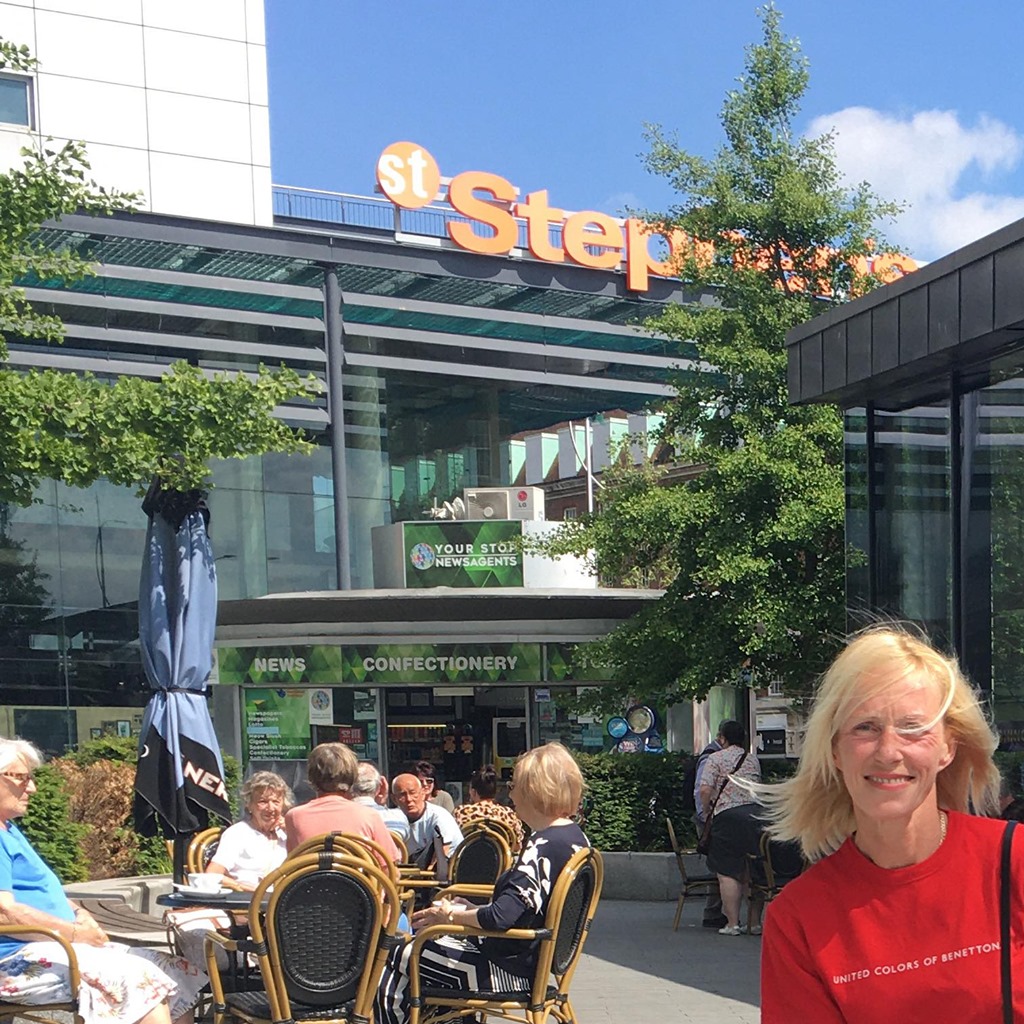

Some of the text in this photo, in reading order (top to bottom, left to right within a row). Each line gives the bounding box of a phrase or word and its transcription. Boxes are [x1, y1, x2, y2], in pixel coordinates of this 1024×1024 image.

[378, 149, 428, 199] st
[435, 544, 517, 554] YOUR STOP
[435, 556, 518, 568] NEWSAGENTS
[254, 657, 306, 672] NEWS
[363, 656, 518, 672] CONFECTIONERY
[833, 969, 870, 984] UNITED
[874, 960, 919, 977] COLORS
[923, 956, 938, 967] OF
